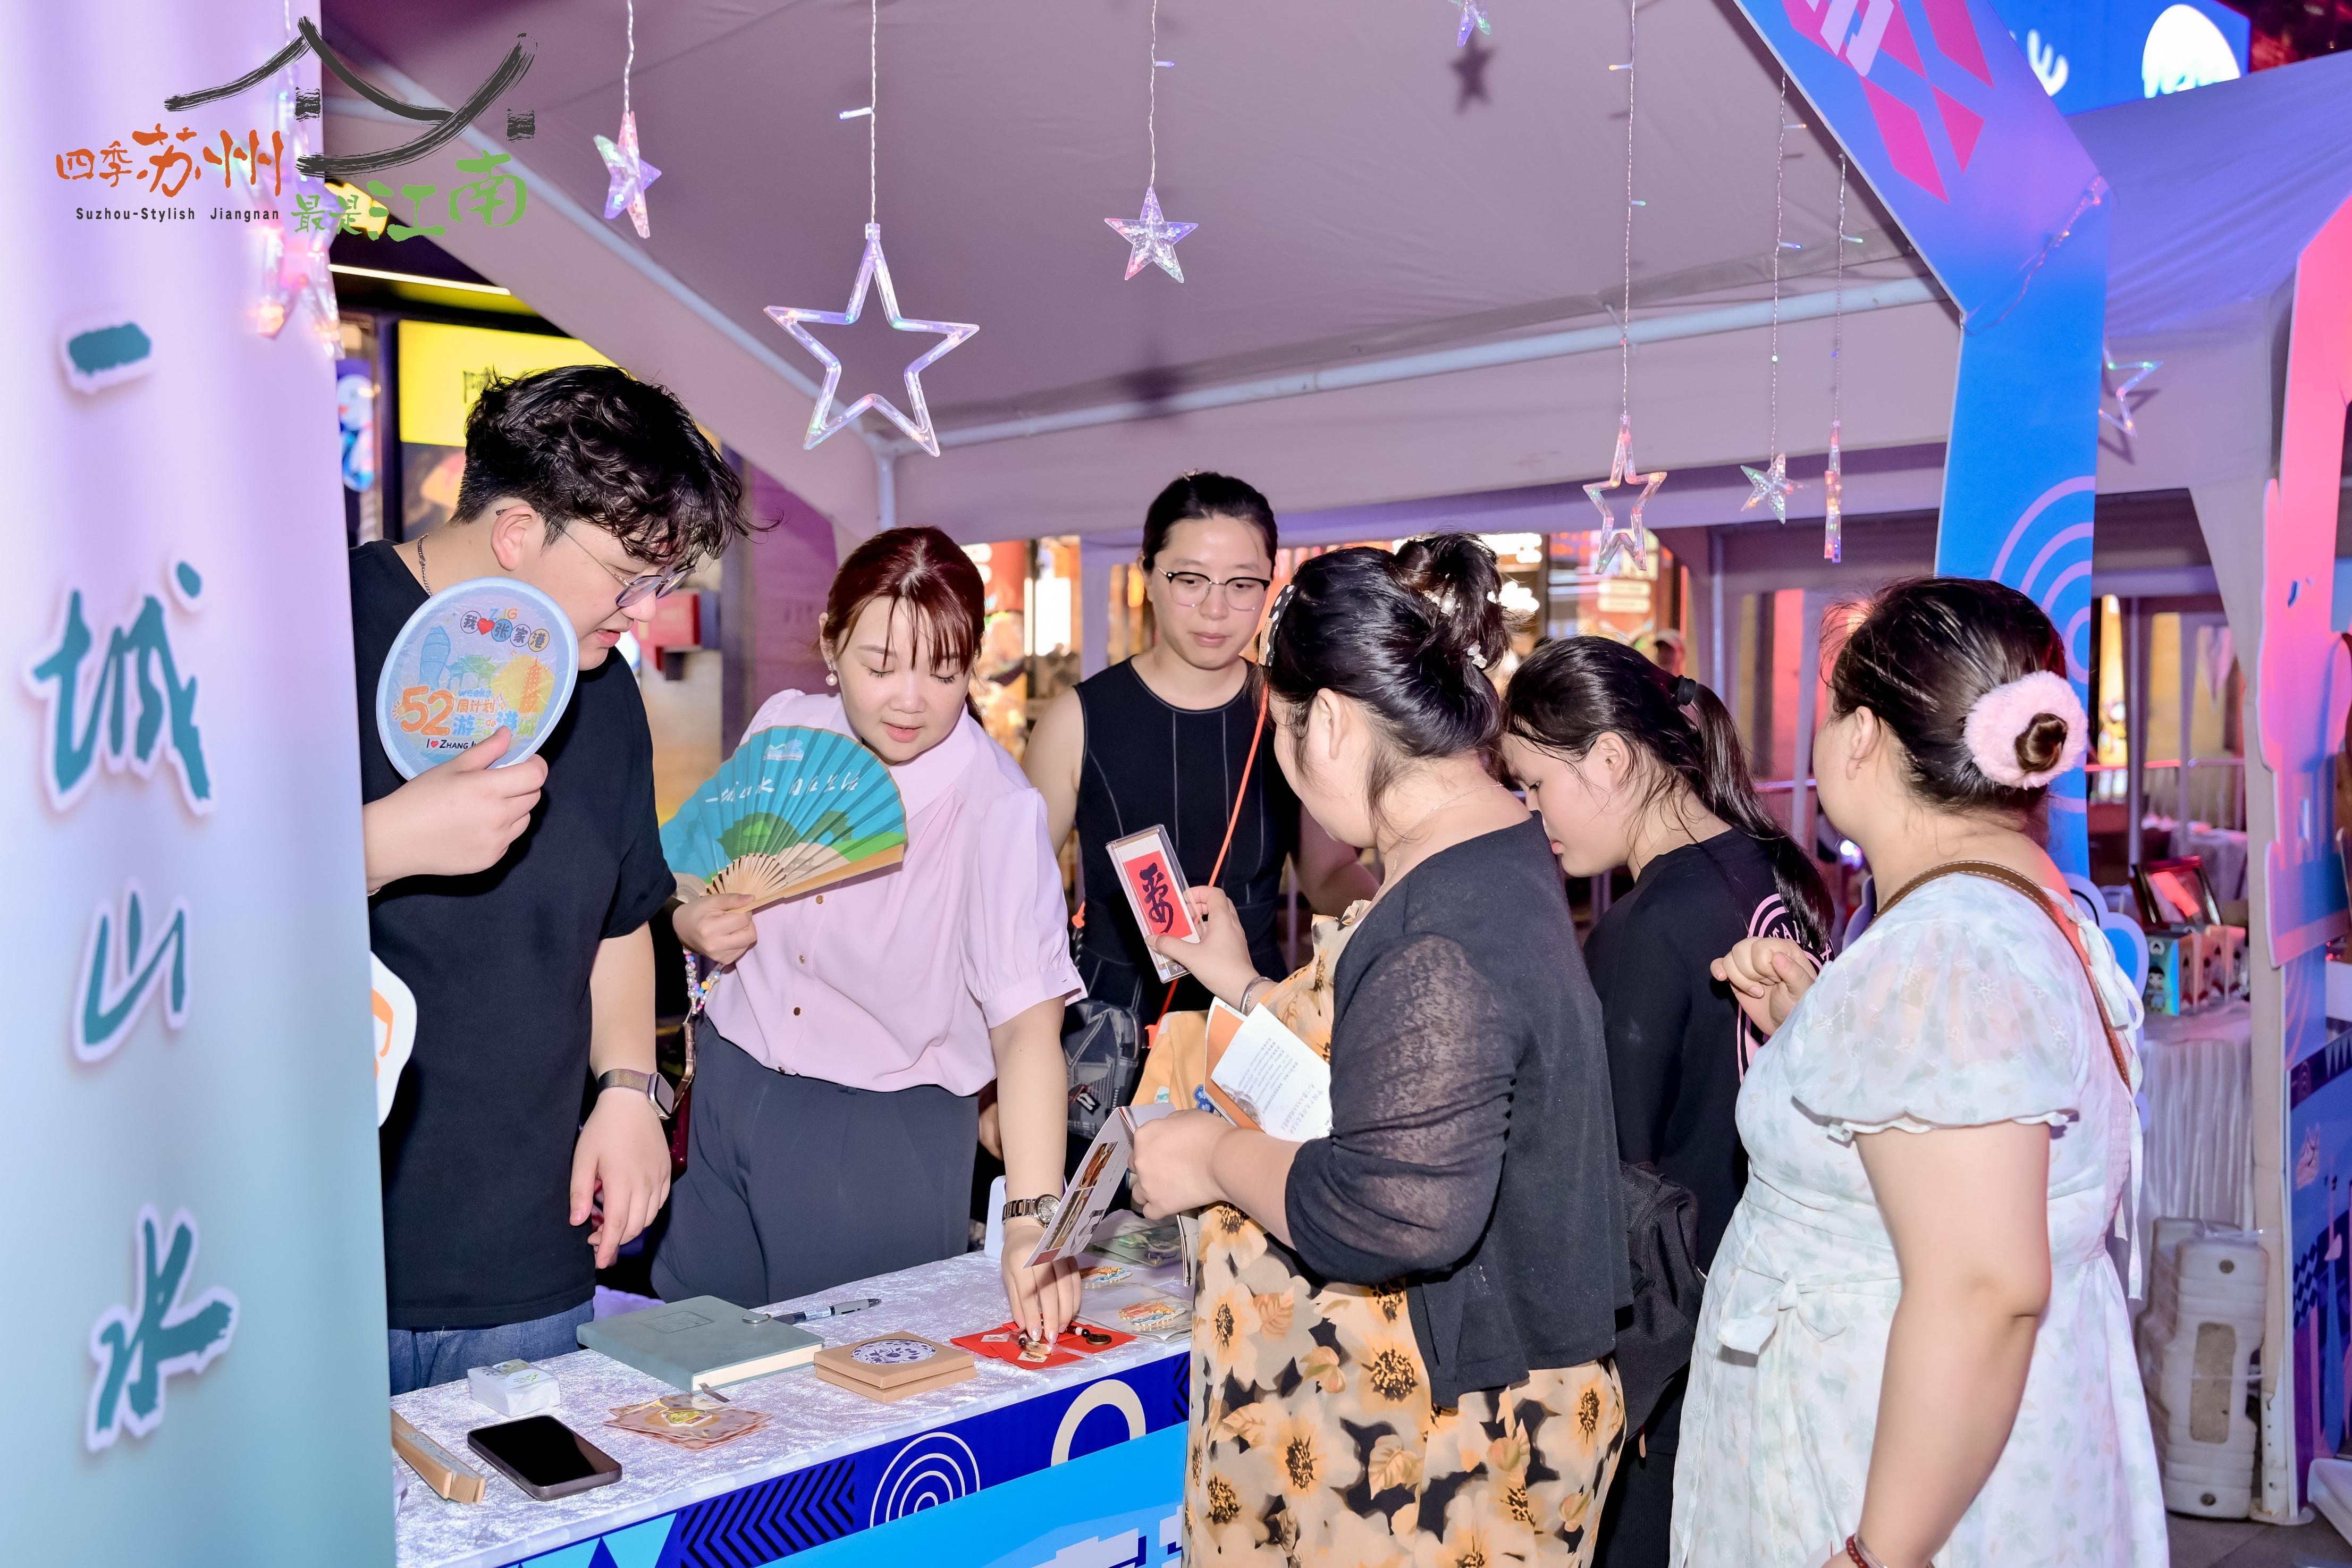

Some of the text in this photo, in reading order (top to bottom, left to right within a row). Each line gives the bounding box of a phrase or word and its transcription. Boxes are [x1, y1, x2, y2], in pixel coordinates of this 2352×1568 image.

[490, 608, 518, 620] ZJG
[494, 623, 545, 649] 张家港
[400, 686, 454, 736] 52
[457, 698, 496, 713] 周计划
